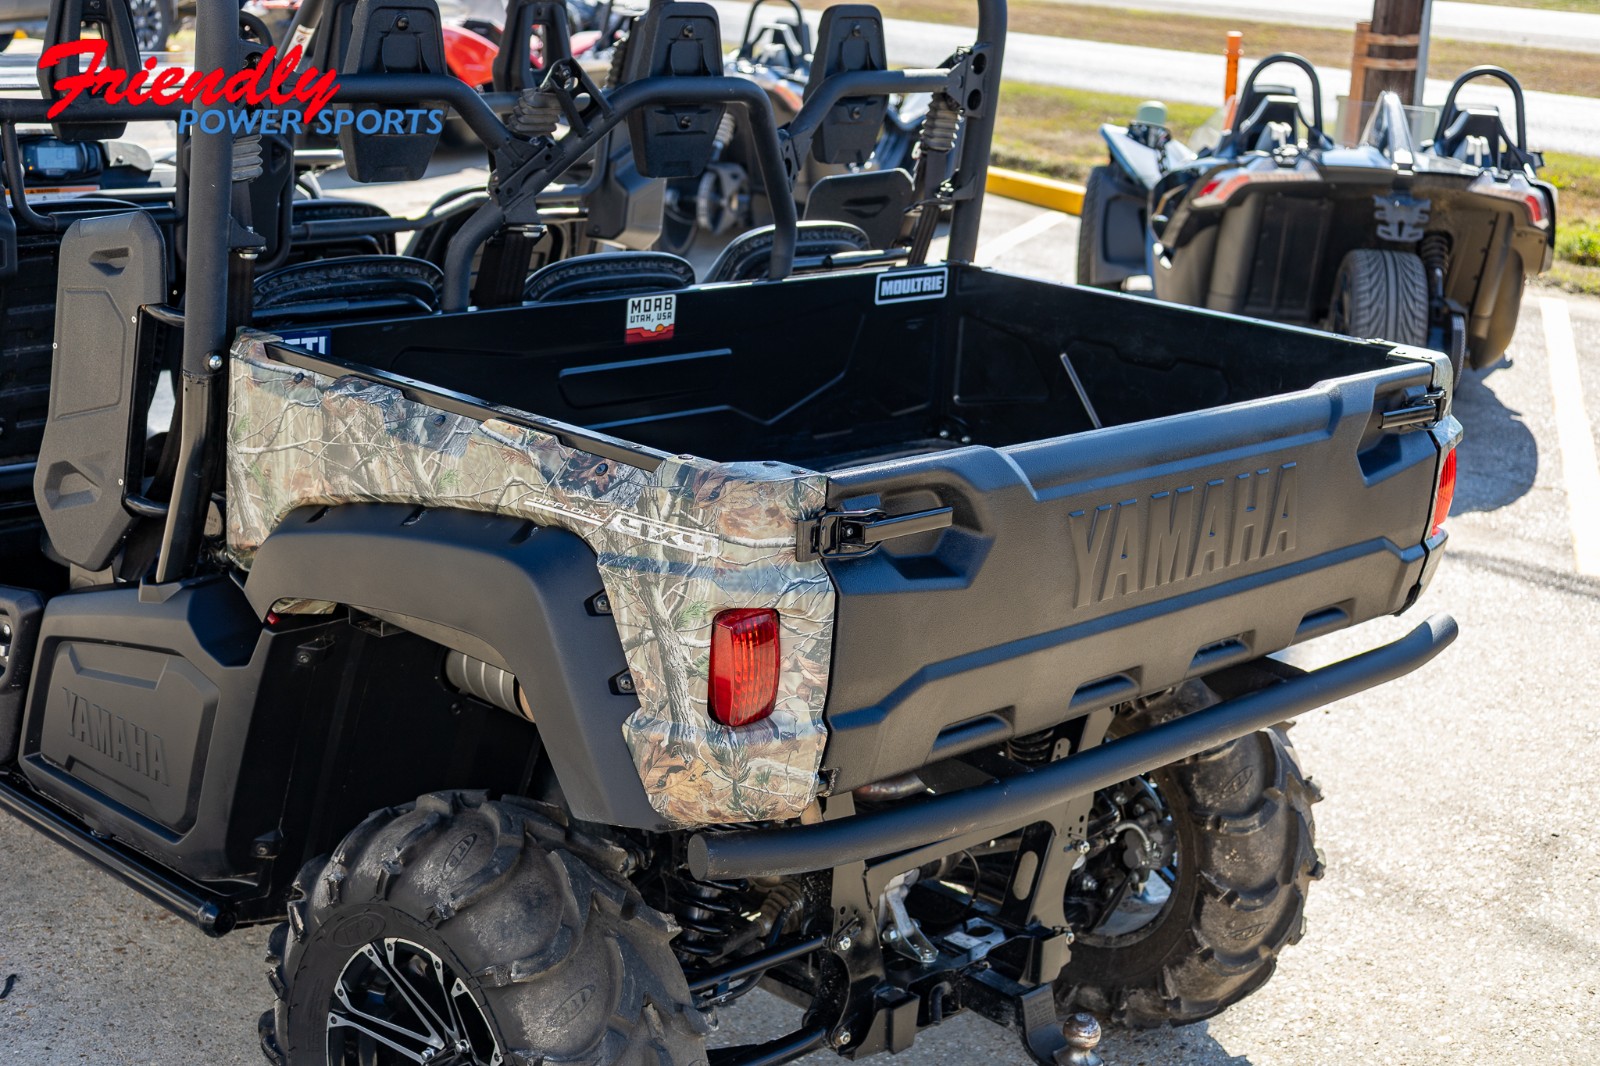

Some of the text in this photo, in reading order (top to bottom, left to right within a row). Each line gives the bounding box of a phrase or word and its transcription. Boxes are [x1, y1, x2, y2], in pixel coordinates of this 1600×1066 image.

[881, 275, 944, 297] MOULTRIE
[631, 297, 672, 314] MOAB
[630, 311, 672, 323] UTAH, USA
[1068, 461, 1297, 610] YAMAHA
[62, 686, 169, 788] YAMAHA
